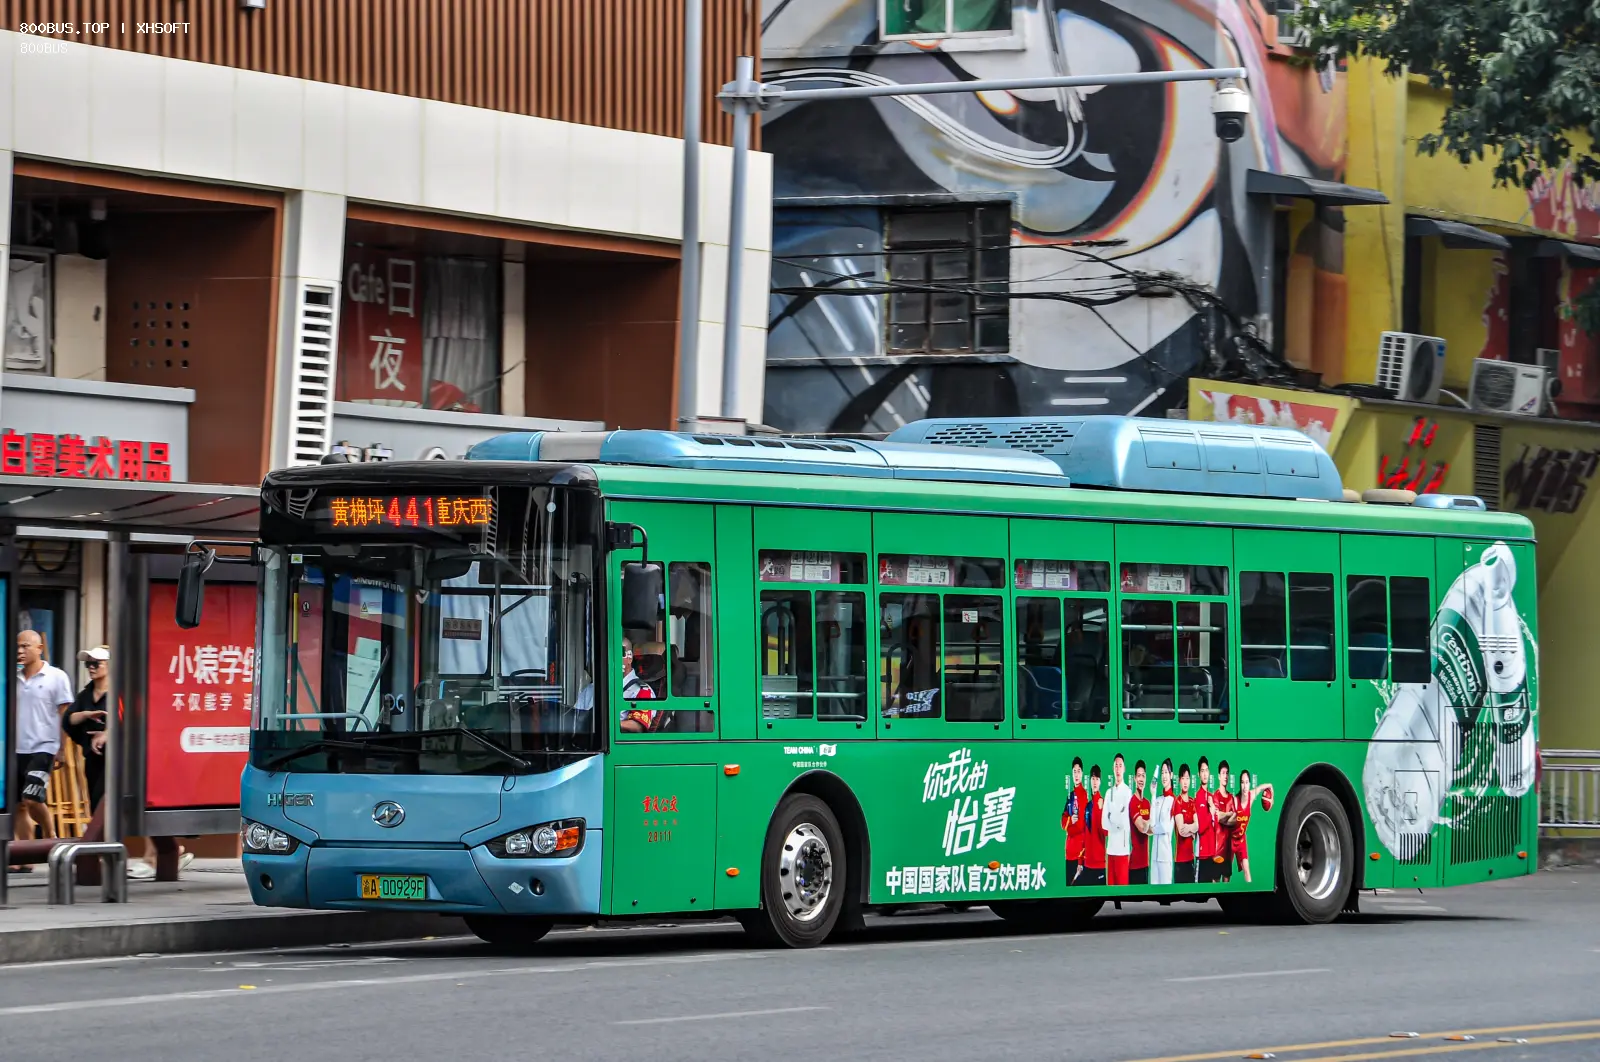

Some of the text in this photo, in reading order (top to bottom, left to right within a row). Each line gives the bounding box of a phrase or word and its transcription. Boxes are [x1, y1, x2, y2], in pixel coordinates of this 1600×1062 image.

[368, 328, 406, 392] 夜
[2, 428, 172, 482] 白雪美术用品
[387, 497, 434, 527] 441
[922, 747, 989, 804] 你我的
[1238, 823, 1247, 836] 5
[886, 861, 1047, 895] 中国国家队官方饮用水
